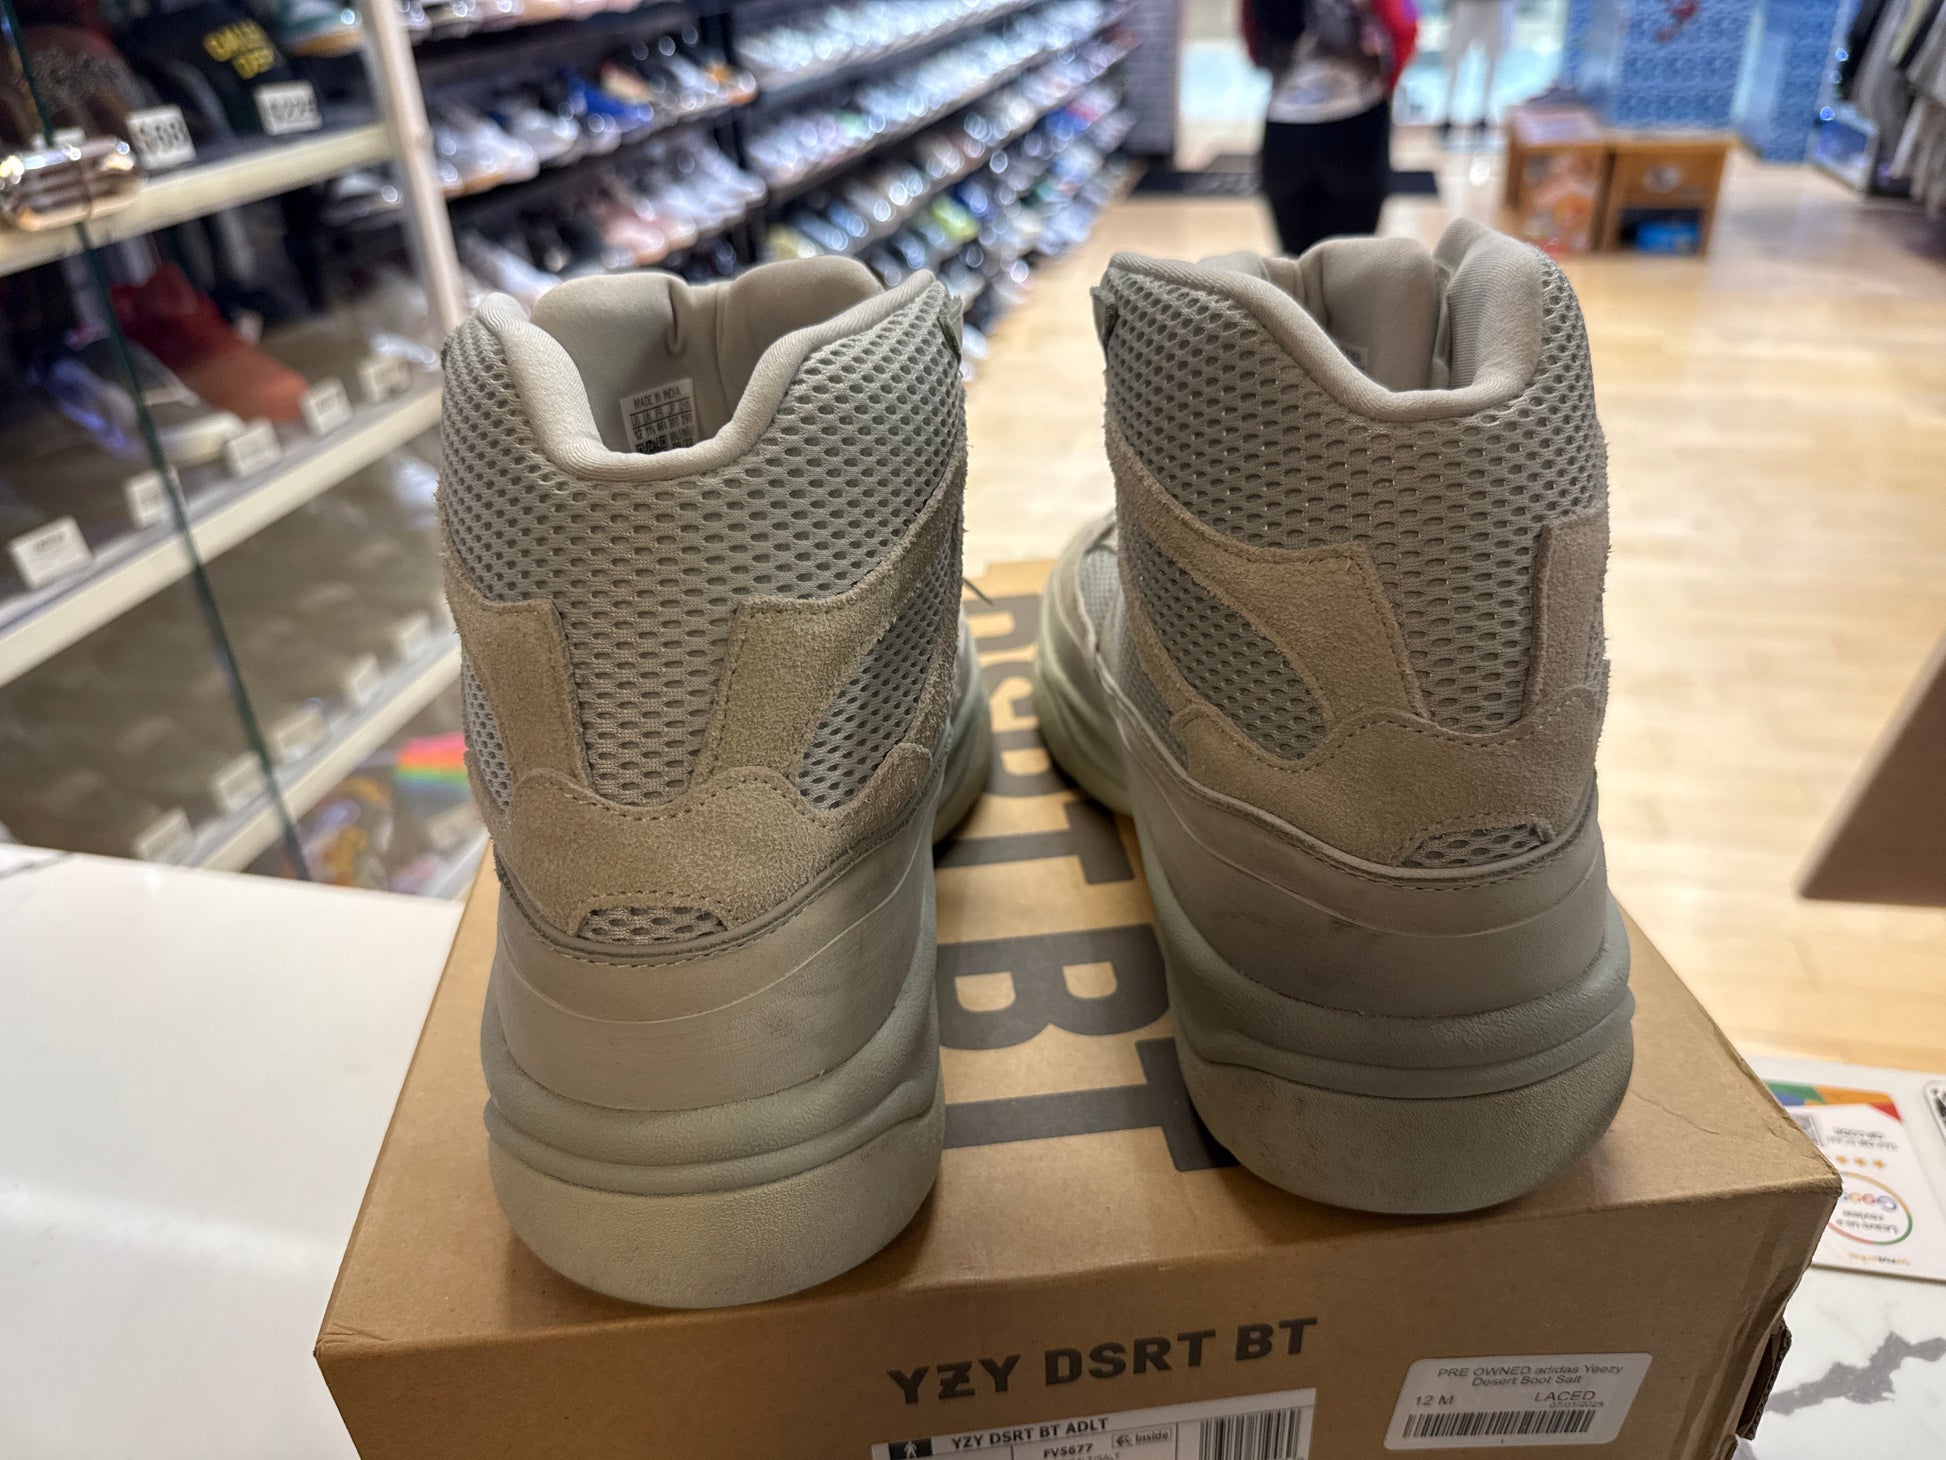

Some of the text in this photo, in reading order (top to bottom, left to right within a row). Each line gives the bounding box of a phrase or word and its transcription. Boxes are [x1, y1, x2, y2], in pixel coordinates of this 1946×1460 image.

[1044, 1328, 1217, 1386] DSRT
[1235, 1316, 1318, 1362] BT
[1437, 1363, 1624, 1378] PRE OWNED adidas Yeezy
[1471, 1373, 1582, 1387] Desert Boot Salt
[1414, 1390, 1596, 1406] 12 M LACED
[951, 1417, 1110, 1450] YZY DSRT BT ADLT
[1043, 1429, 1169, 1459] FV5677 Inside
